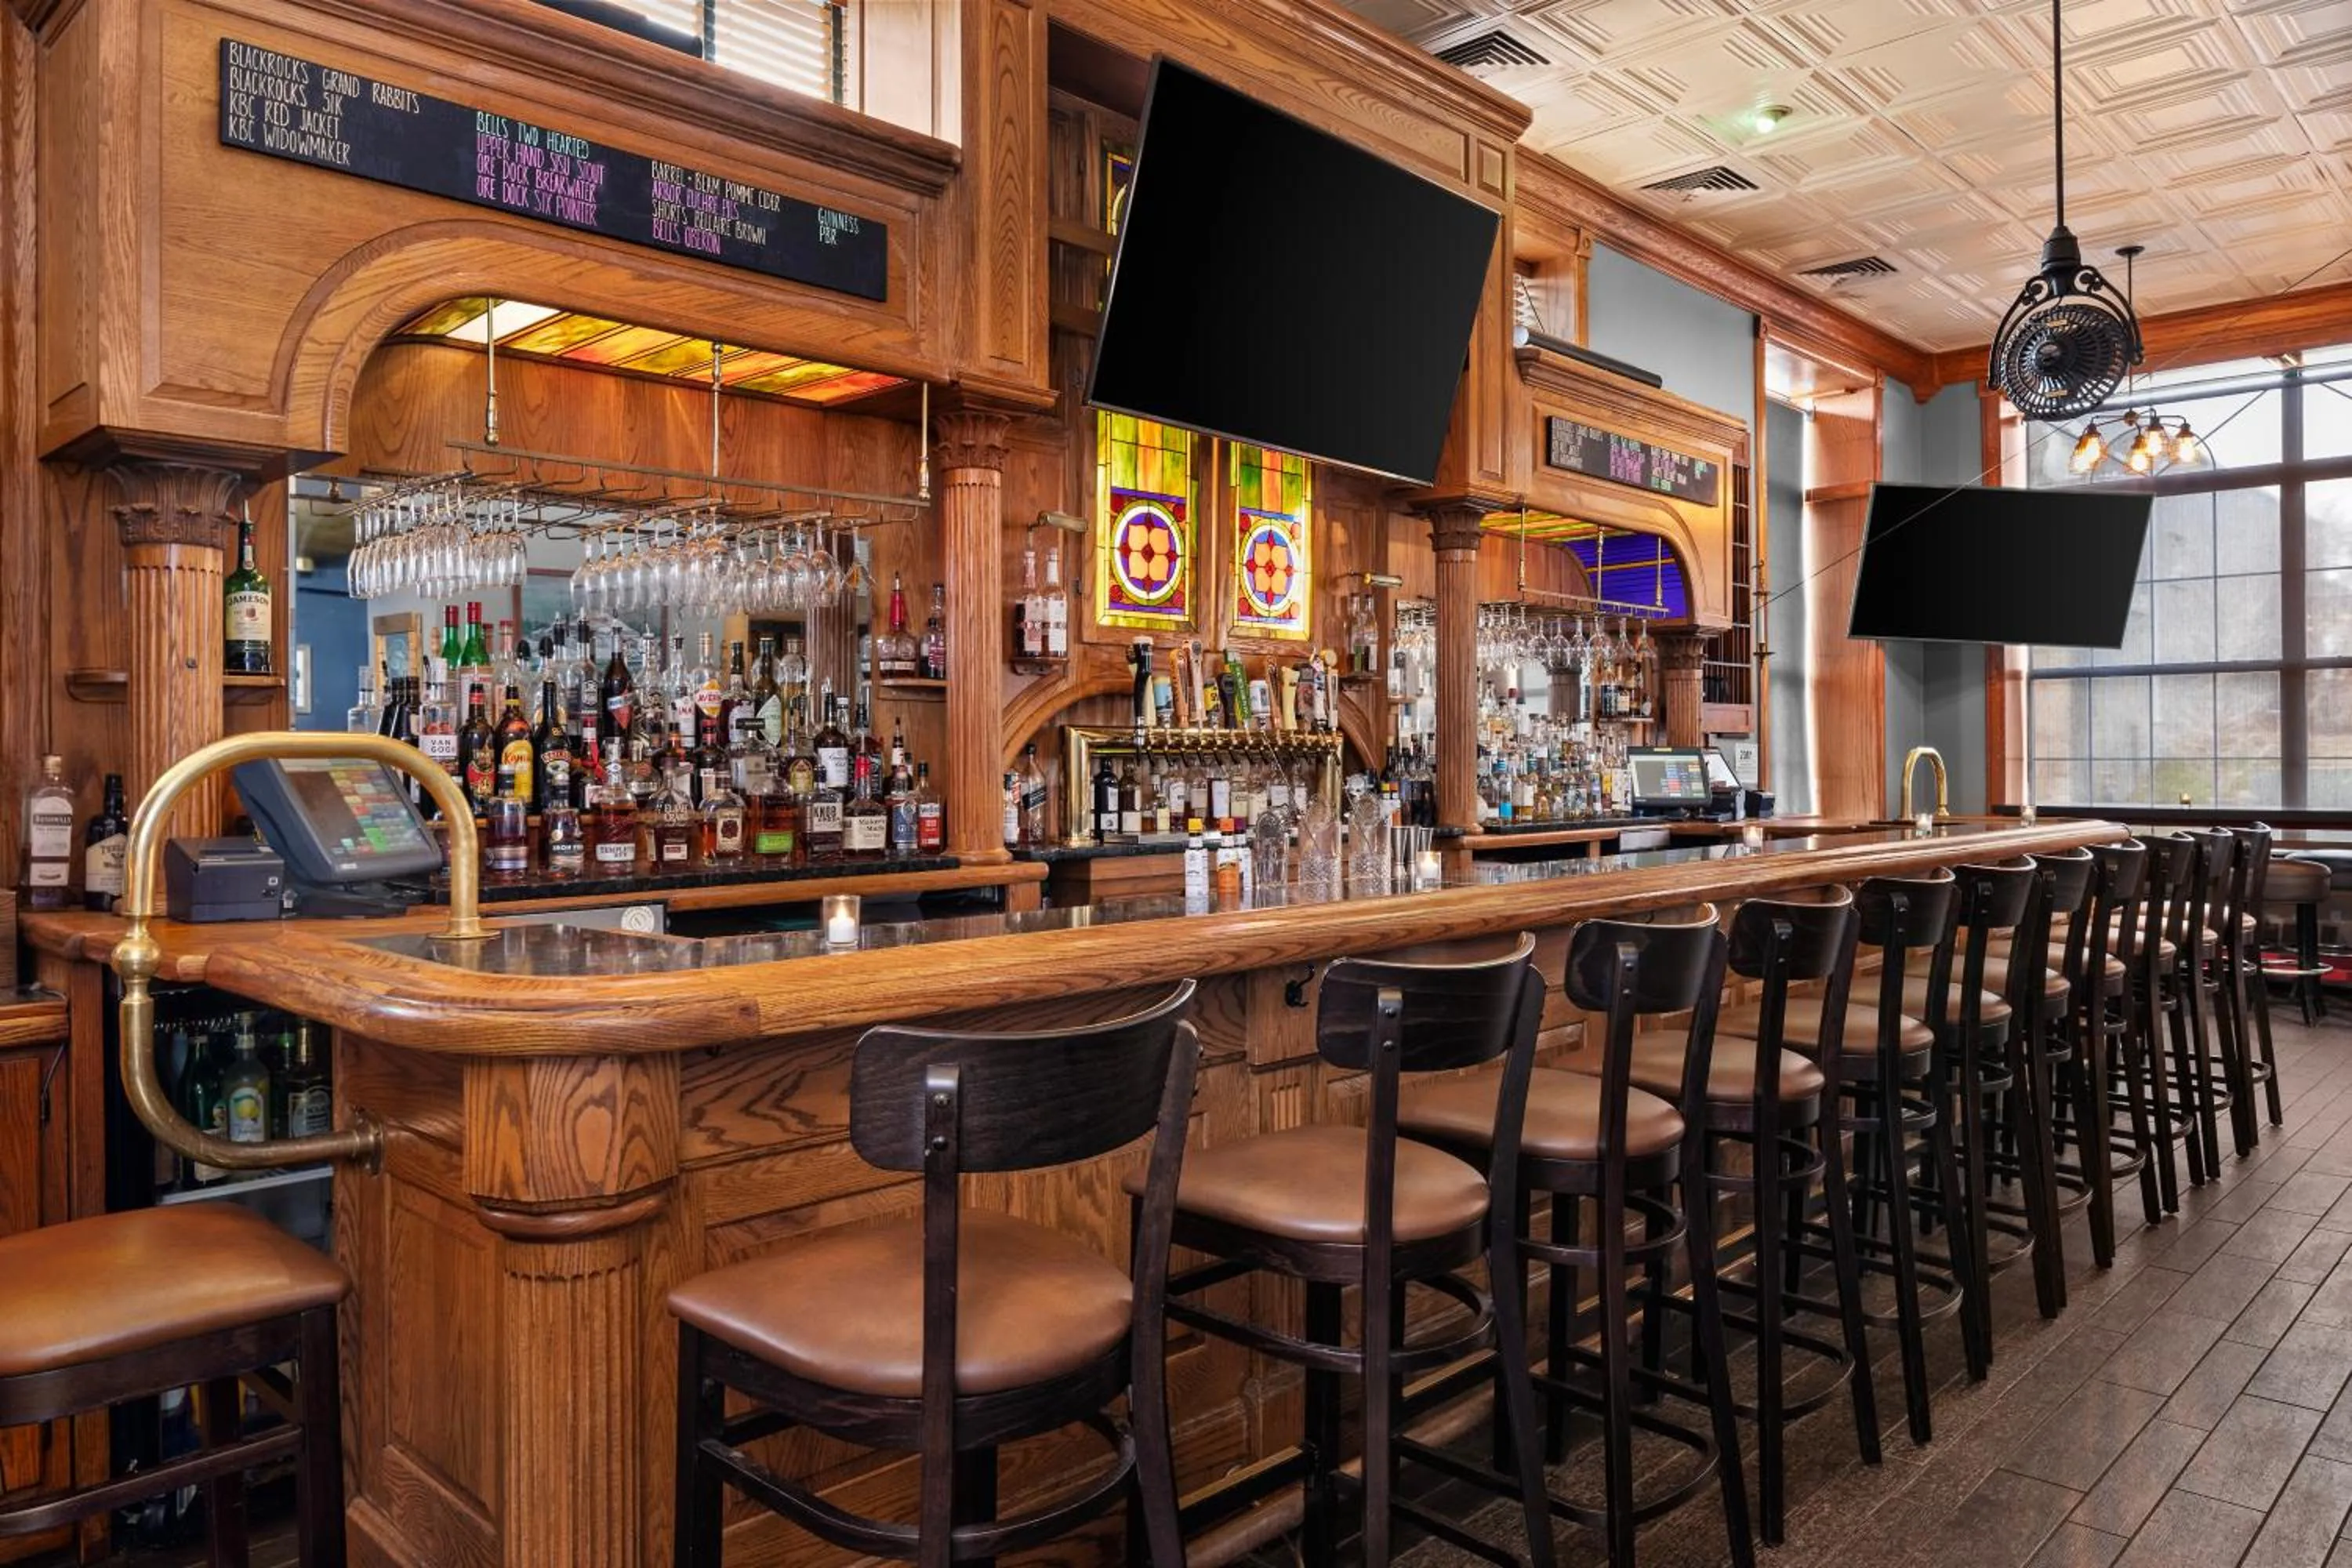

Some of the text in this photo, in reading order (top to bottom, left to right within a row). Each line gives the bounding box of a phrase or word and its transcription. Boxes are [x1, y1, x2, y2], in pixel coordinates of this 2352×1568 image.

[230, 42, 419, 114] BLACKROCKS GRAND RABBITS
[230, 66, 307, 107] BLACKROCKS
[228, 114, 350, 166] KBC WIDOWMAKER
[229, 90, 339, 140] KBC RED JACKET
[477, 111, 590, 159] BELLS TWO HEARTED
[477, 132, 510, 160] UPPER
[515, 143, 544, 169] HAND
[577, 160, 604, 185] STOUT
[477, 153, 596, 203] ORE DOCK BREAKWATER
[477, 175, 597, 226] ORE DOCK SIX POINTER
[652, 161, 685, 187] BARREL
[695, 172, 720, 195] BEAM
[725, 181, 755, 206] POMME
[758, 190, 780, 212] CIDER
[652, 218, 720, 255] BELLS OBERON
[694, 211, 731, 236] BELLAIRE
[735, 220, 766, 245] BROWN
[818, 207, 859, 235] GUINNESS
[819, 225, 837, 245] PBR
